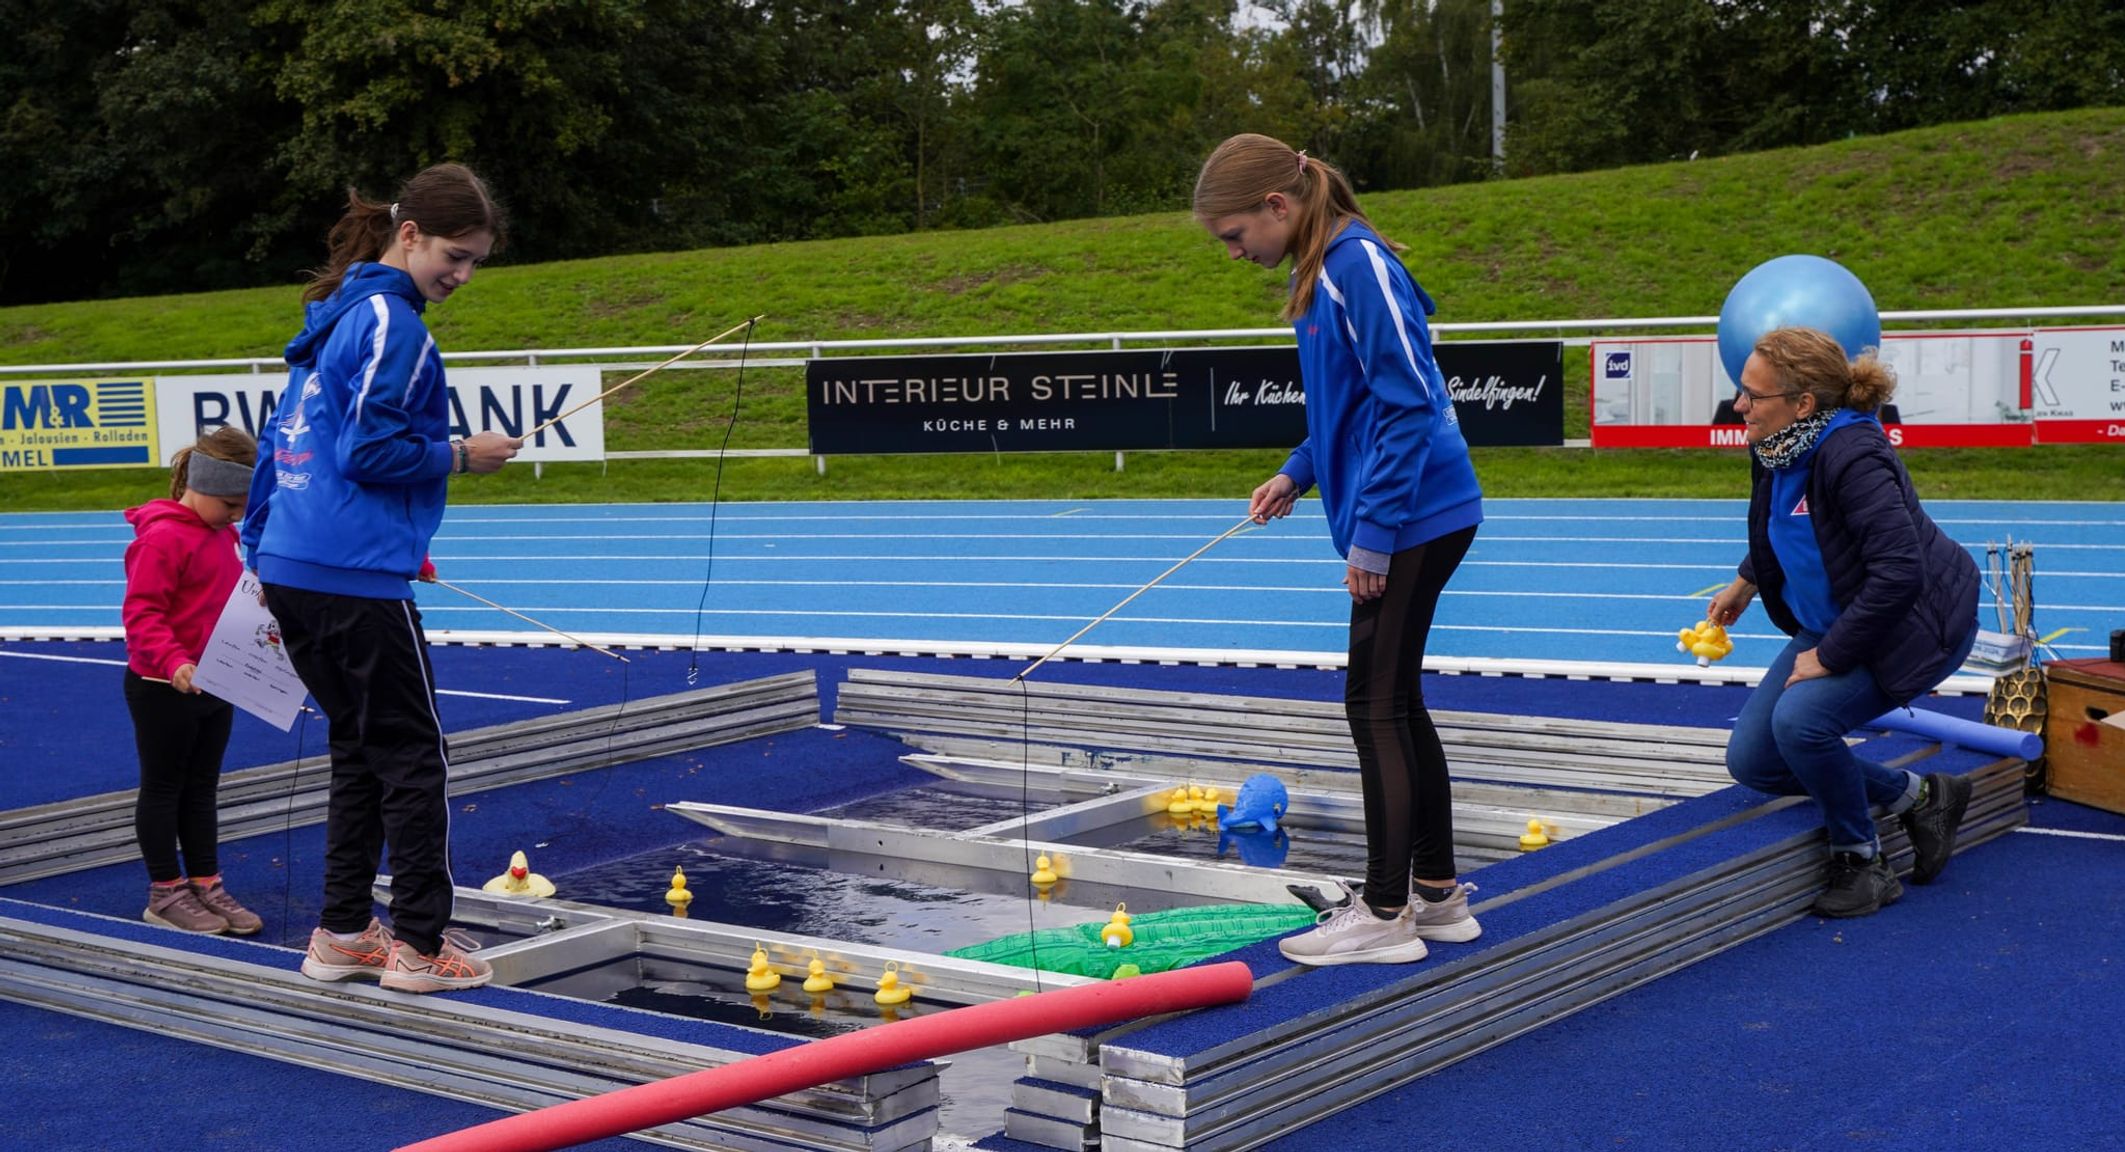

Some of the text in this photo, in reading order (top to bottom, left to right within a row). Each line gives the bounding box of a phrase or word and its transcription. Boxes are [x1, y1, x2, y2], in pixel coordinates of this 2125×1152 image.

[1607, 359, 1629, 371] ivd
[823, 372, 1178, 404] INTERIEUR STEINLE
[1224, 380, 1250, 405] Ihr
[1447, 375, 1547, 411] Sindelfingen!
[2, 384, 95, 430] M&R
[447, 384, 577, 448] ANK
[923, 418, 1076, 432] KÜCHE & MEHR
[21, 431, 78, 445] Jalousien
[93, 430, 148, 442] Rolladen
[1710, 429, 1748, 446] IMM
